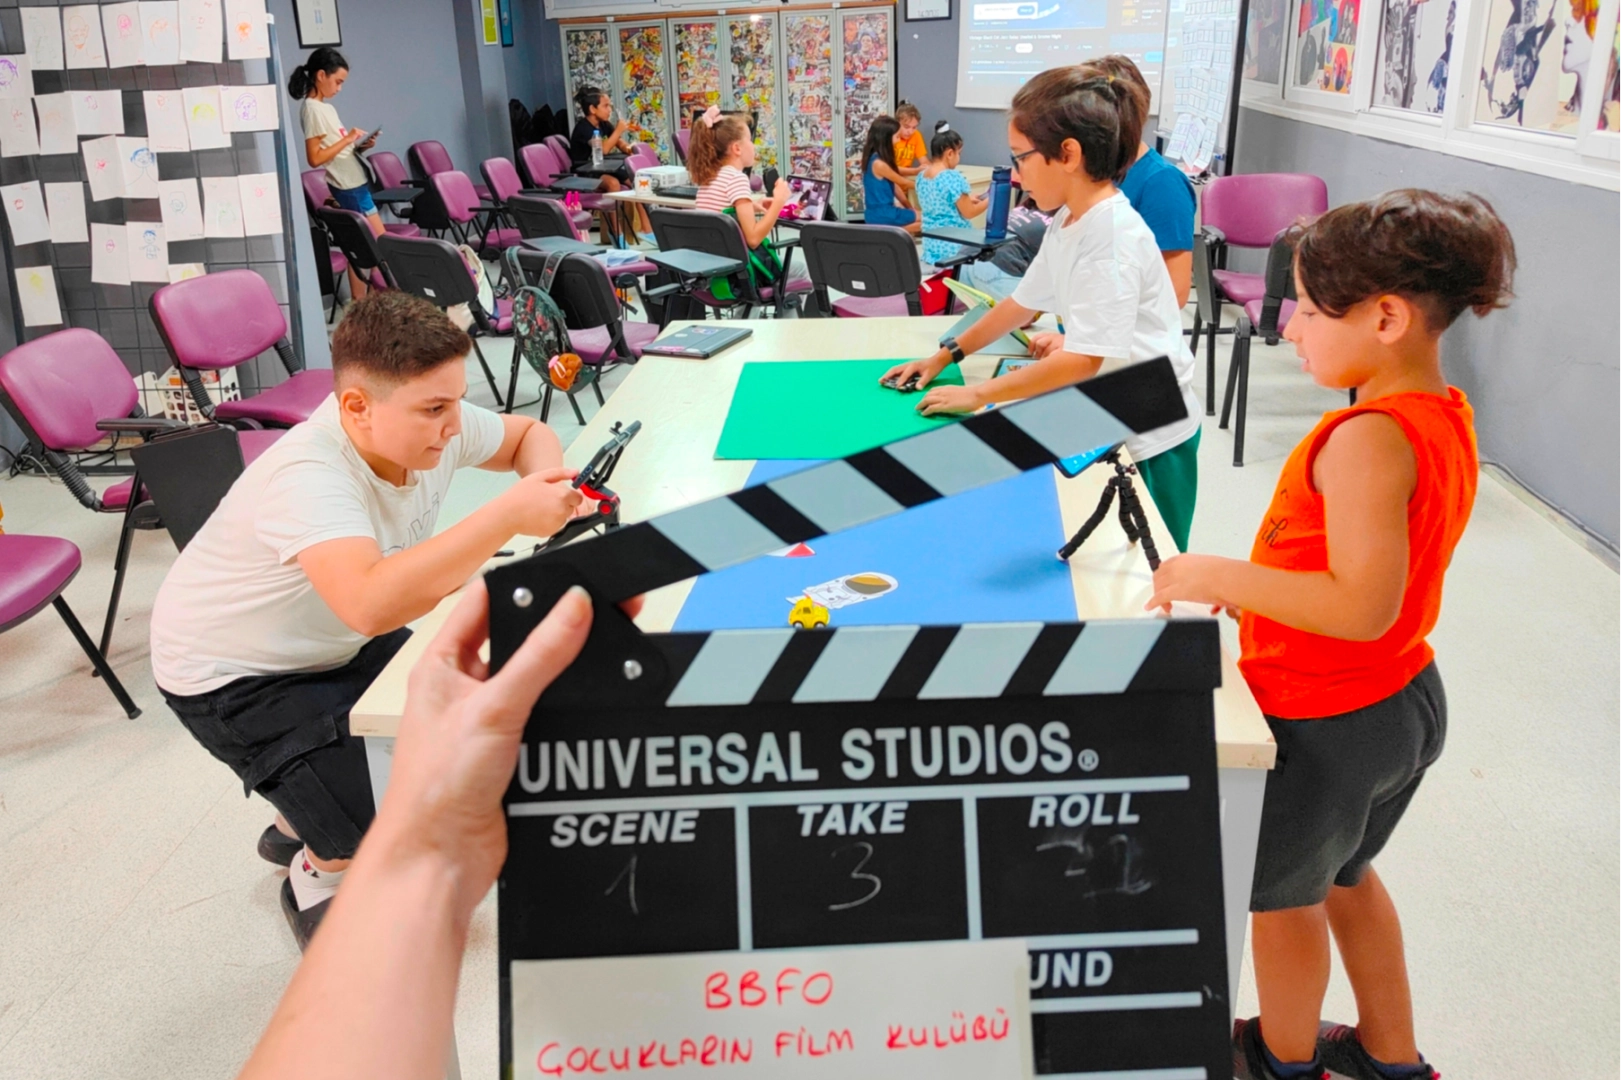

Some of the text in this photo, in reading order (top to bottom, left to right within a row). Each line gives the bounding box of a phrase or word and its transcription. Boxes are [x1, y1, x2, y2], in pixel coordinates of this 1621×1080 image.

[518, 731, 819, 793] UNIVERSAL
[550, 810, 700, 847] SCENE
[797, 801, 909, 837] TAKE
[1028, 793, 1140, 828] ROLL
[827, 841, 882, 911] 3
[705, 968, 833, 1010] BBFO
